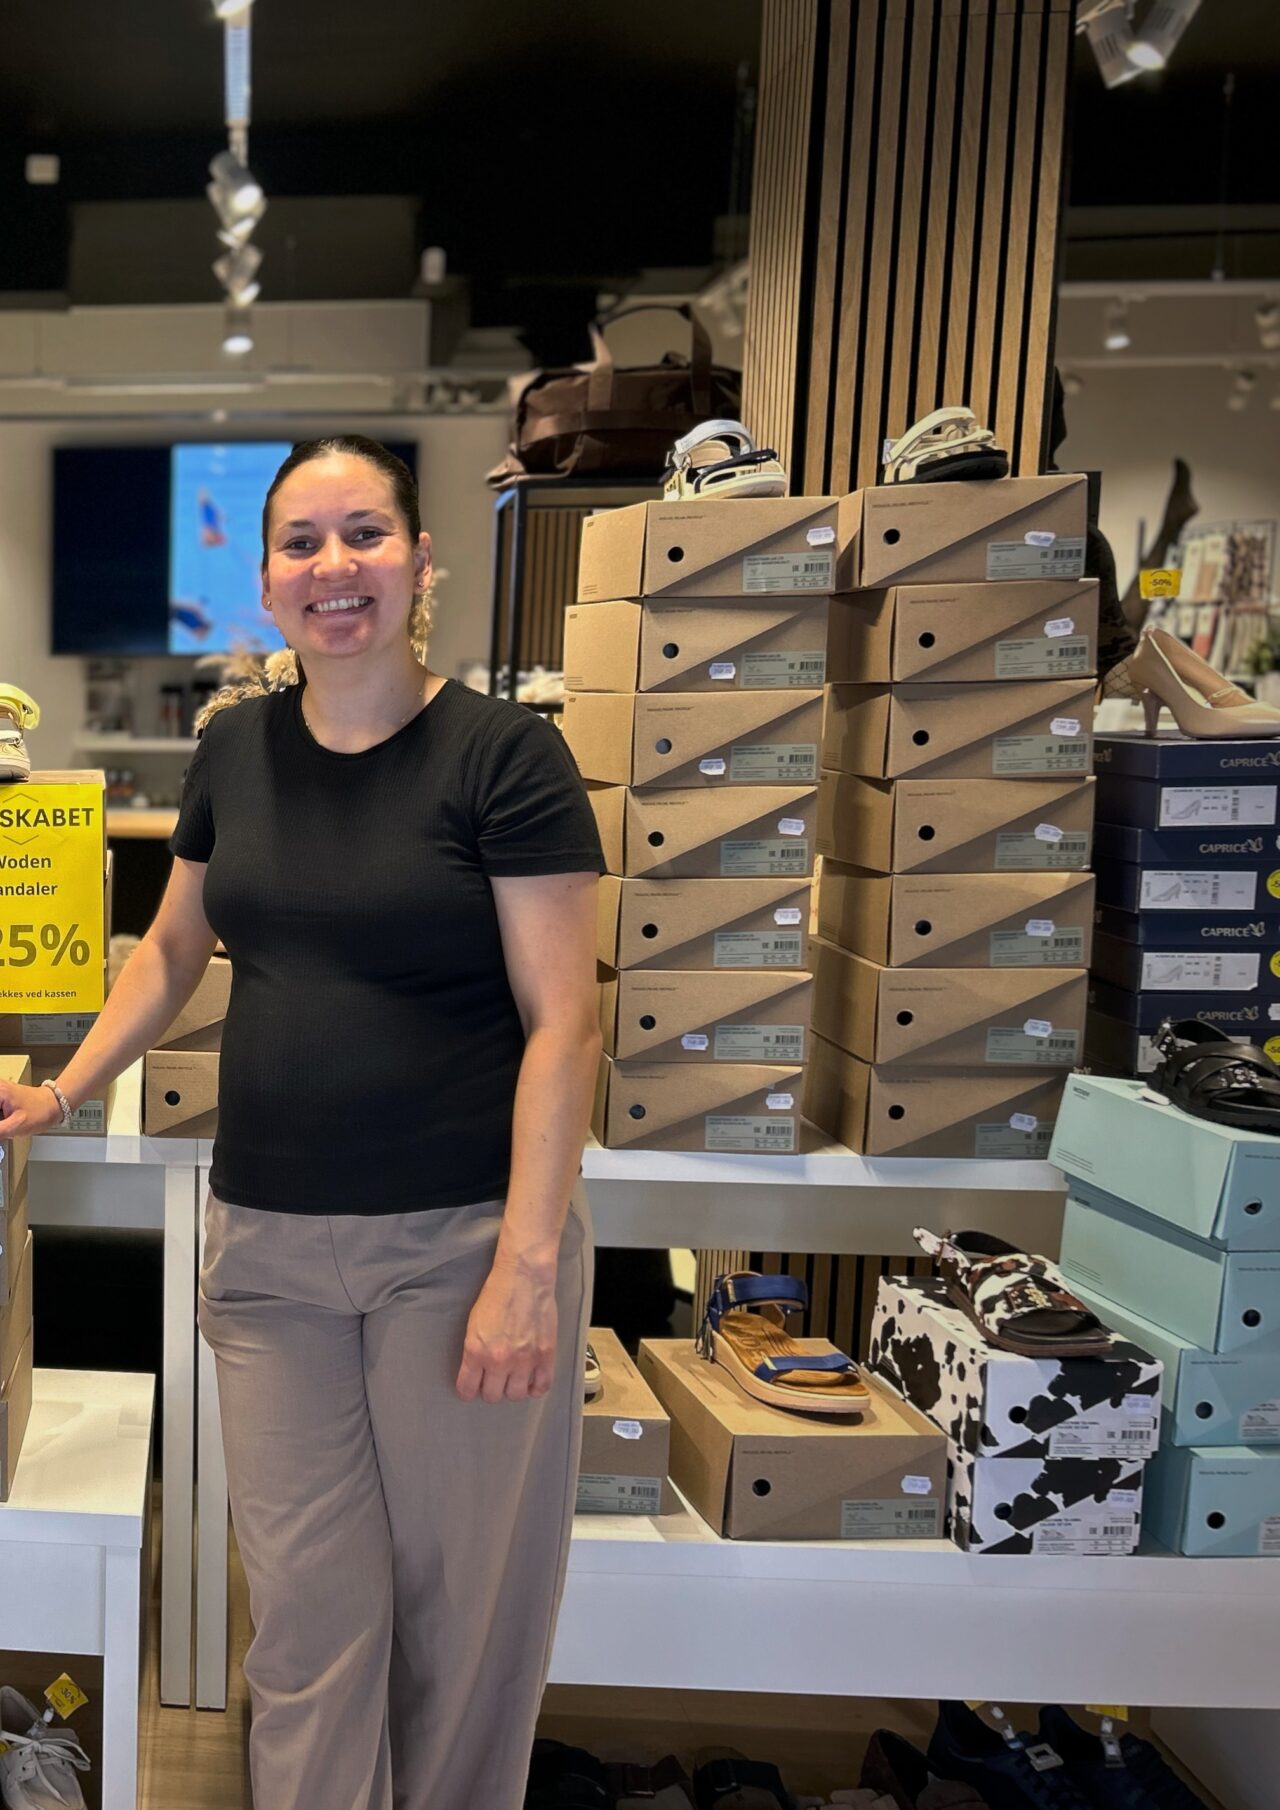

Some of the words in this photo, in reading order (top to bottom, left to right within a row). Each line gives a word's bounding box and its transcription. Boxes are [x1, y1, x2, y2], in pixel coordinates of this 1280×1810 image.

[1220, 757, 1268, 768] CAPRICE
[1200, 843, 1248, 853] CAPRICE
[1200, 927, 1250, 937] CAPRICE
[25, 989, 42, 998] ved
[44, 989, 77, 998] kassen
[1196, 1011, 1244, 1021] CAPRICE
